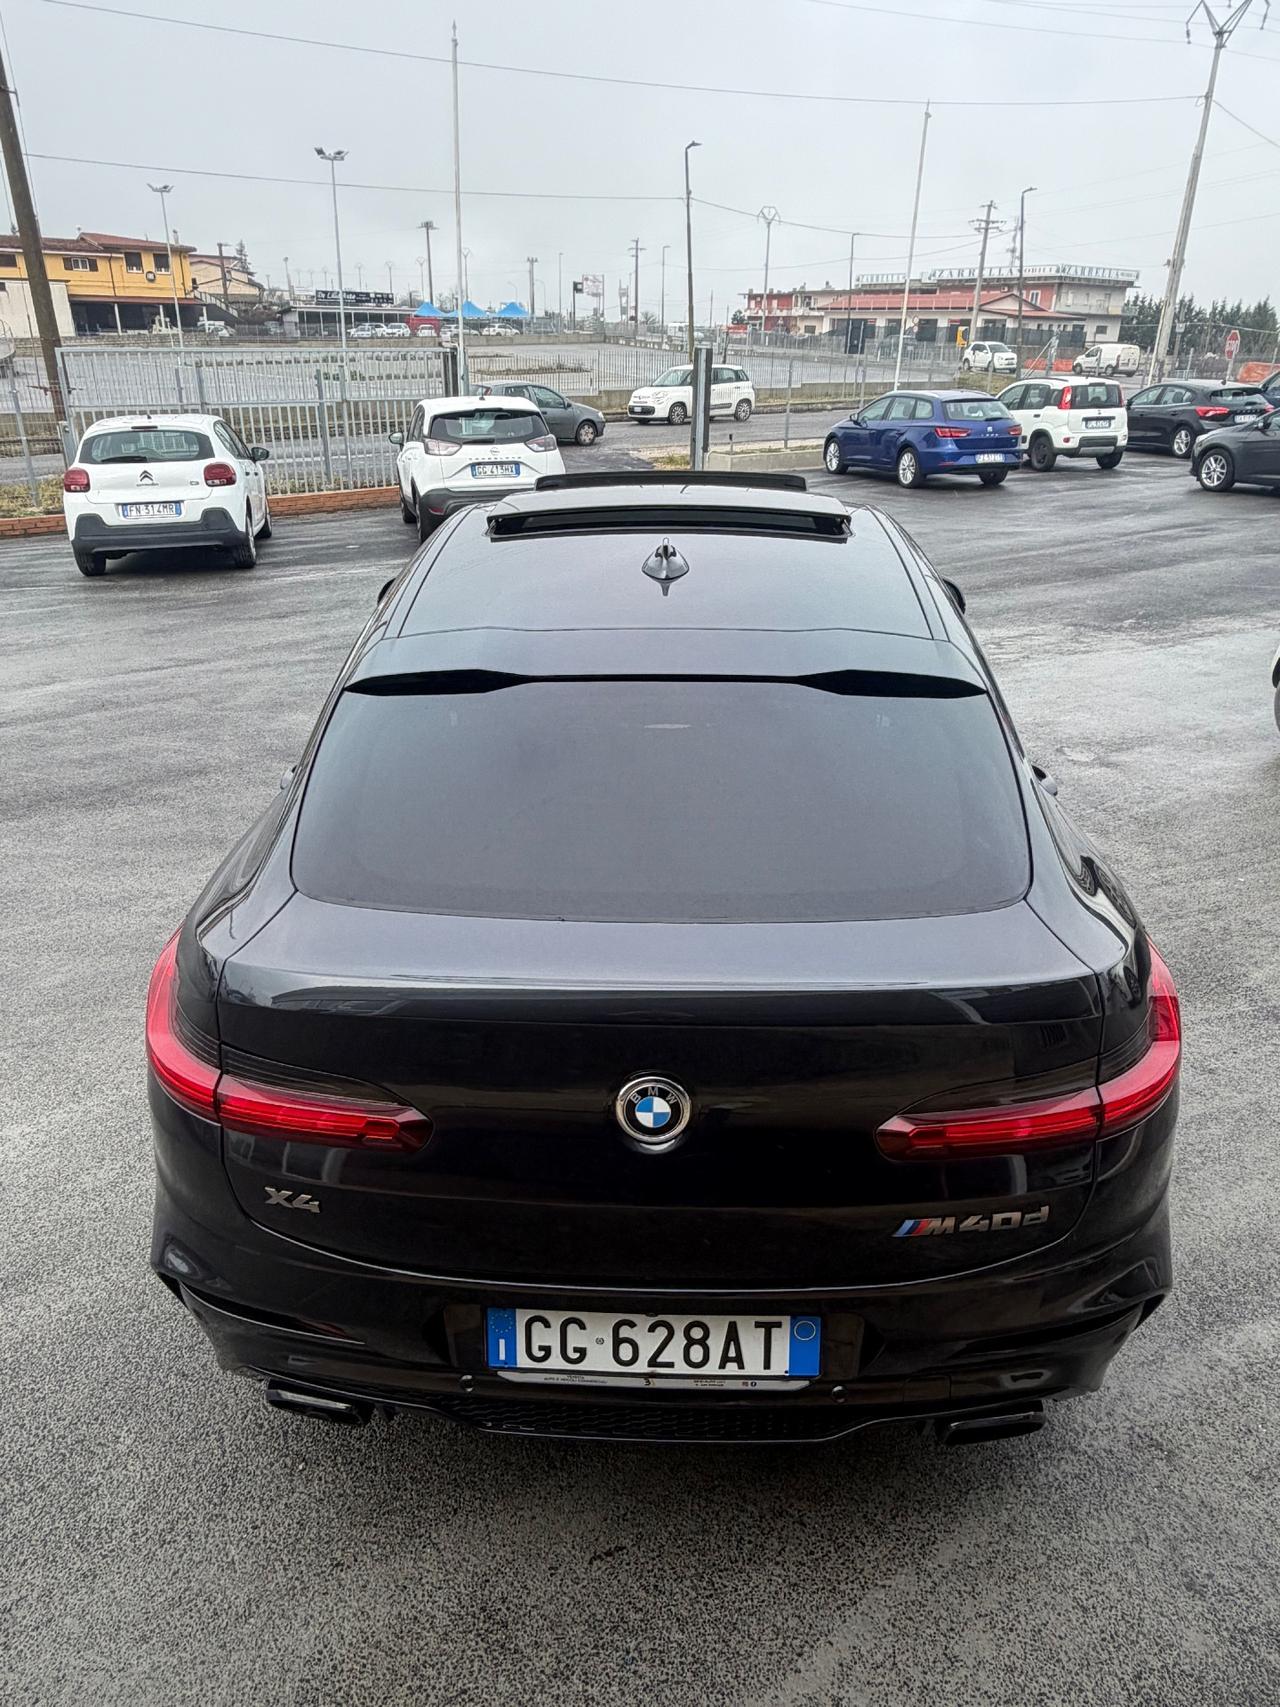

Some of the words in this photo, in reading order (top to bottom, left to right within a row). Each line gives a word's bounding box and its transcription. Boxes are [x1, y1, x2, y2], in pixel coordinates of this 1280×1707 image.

[938, 266, 1015, 278] ZARRLLA
[129, 504, 141, 515] FN
[144, 503, 174, 515] 314MR
[630, 1085, 678, 1105] BMW
[264, 1186, 321, 1213] X4
[524, 1315, 588, 1364] GG
[611, 1318, 783, 1370] 628AT
